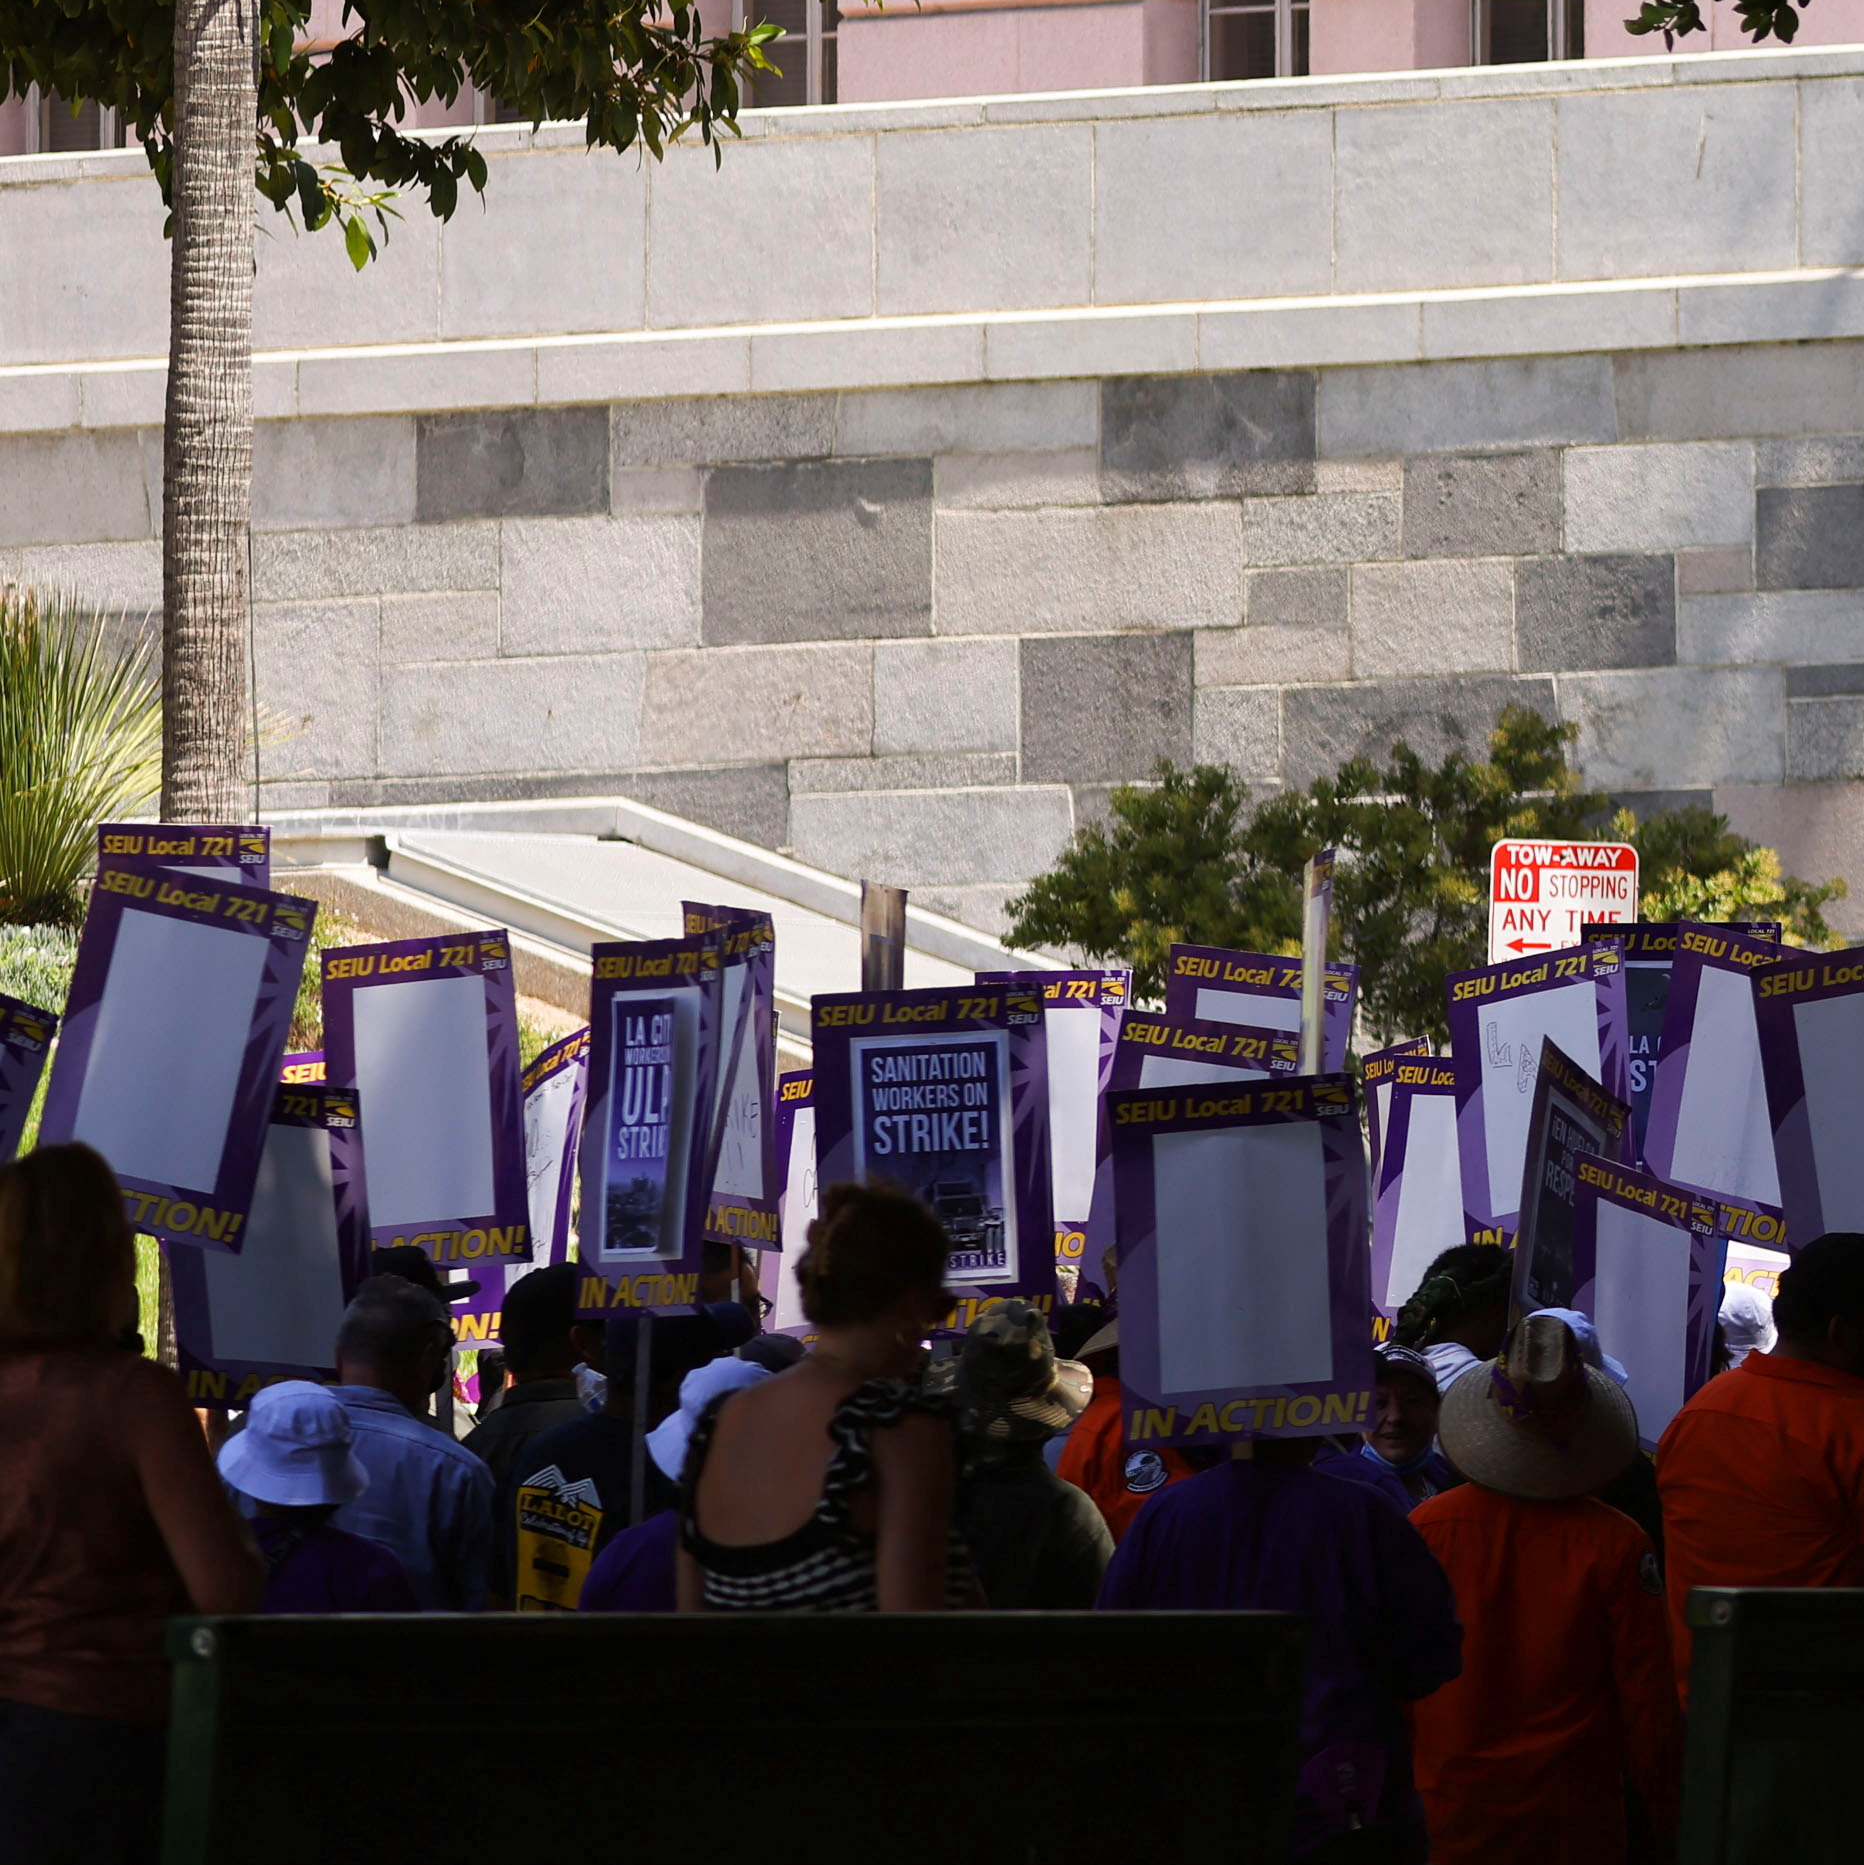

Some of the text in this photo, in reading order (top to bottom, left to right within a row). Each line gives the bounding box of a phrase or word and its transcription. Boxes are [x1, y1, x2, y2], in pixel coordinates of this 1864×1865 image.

[102, 835, 234, 856] SEIU Local 721
[1506, 845, 1622, 869] TOW-AWAY
[1499, 867, 1628, 902] NO STOPPING
[1502, 909, 1621, 932] ANY TIME
[326, 944, 475, 980] SEIU Local 721
[481, 958, 507, 971] SEIU
[1452, 954, 1587, 1002] SEIU Local 721
[1758, 968, 1815, 999] SEIU
[816, 996, 999, 1028] SEIU Local 721
[1122, 1022, 1268, 1059] SEIU Local 721
[1630, 1036, 1650, 1055] LA
[871, 1051, 986, 1083] SANITATION
[872, 1082, 988, 1112] WORKERS ON
[1115, 1089, 1304, 1125] SEIU Local 721
[873, 1110, 990, 1155] STRIKE!
[712, 1207, 778, 1241] ACTION!
[948, 1251, 1006, 1269] STRIKE
[578, 1272, 700, 1309] IN ACTION!
[187, 1370, 227, 1401] IN
[1128, 1391, 1371, 1441] IN ACTION!
